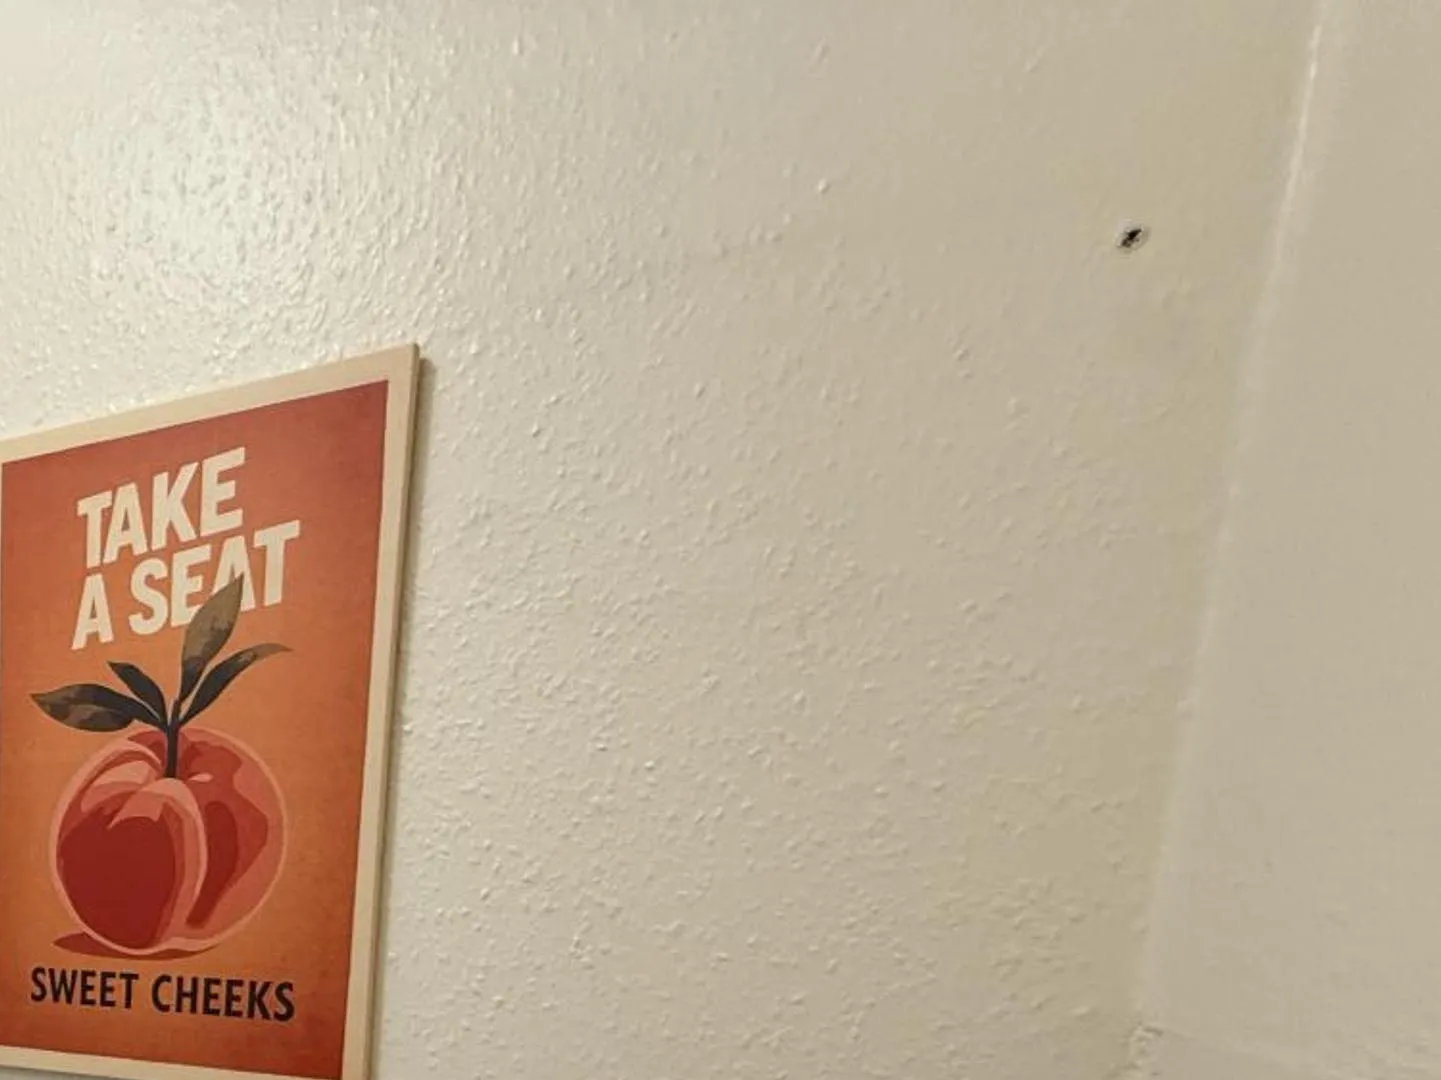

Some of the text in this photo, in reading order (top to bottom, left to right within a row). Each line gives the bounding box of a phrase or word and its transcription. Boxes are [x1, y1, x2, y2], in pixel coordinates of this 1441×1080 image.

[77, 446, 246, 570] TAKE
[71, 519, 301, 651] A SEAT
[30, 966, 296, 1022] SWEET CHEEKS
